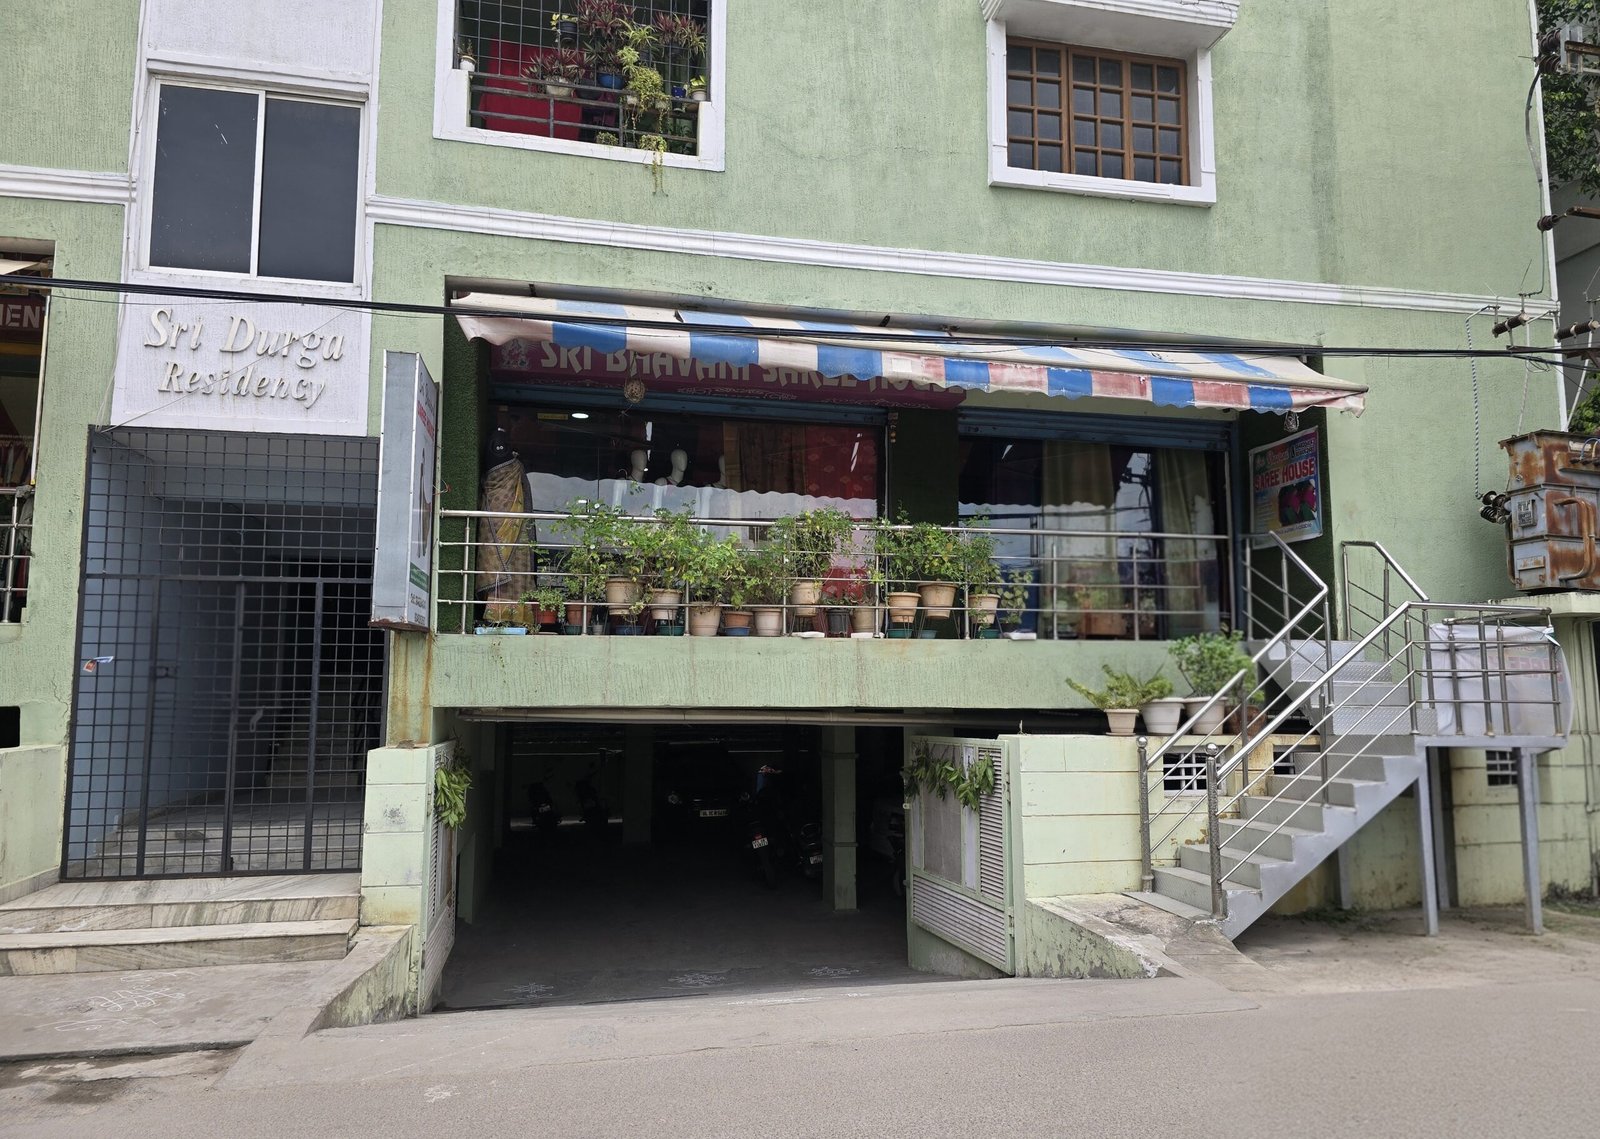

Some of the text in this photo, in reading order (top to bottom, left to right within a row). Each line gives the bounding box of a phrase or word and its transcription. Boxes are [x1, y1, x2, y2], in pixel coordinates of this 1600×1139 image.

[144, 308, 345, 368] Sri Durga
[158, 361, 326, 409] Residency
[1255, 458, 1315, 489] SAREE HOUSE
